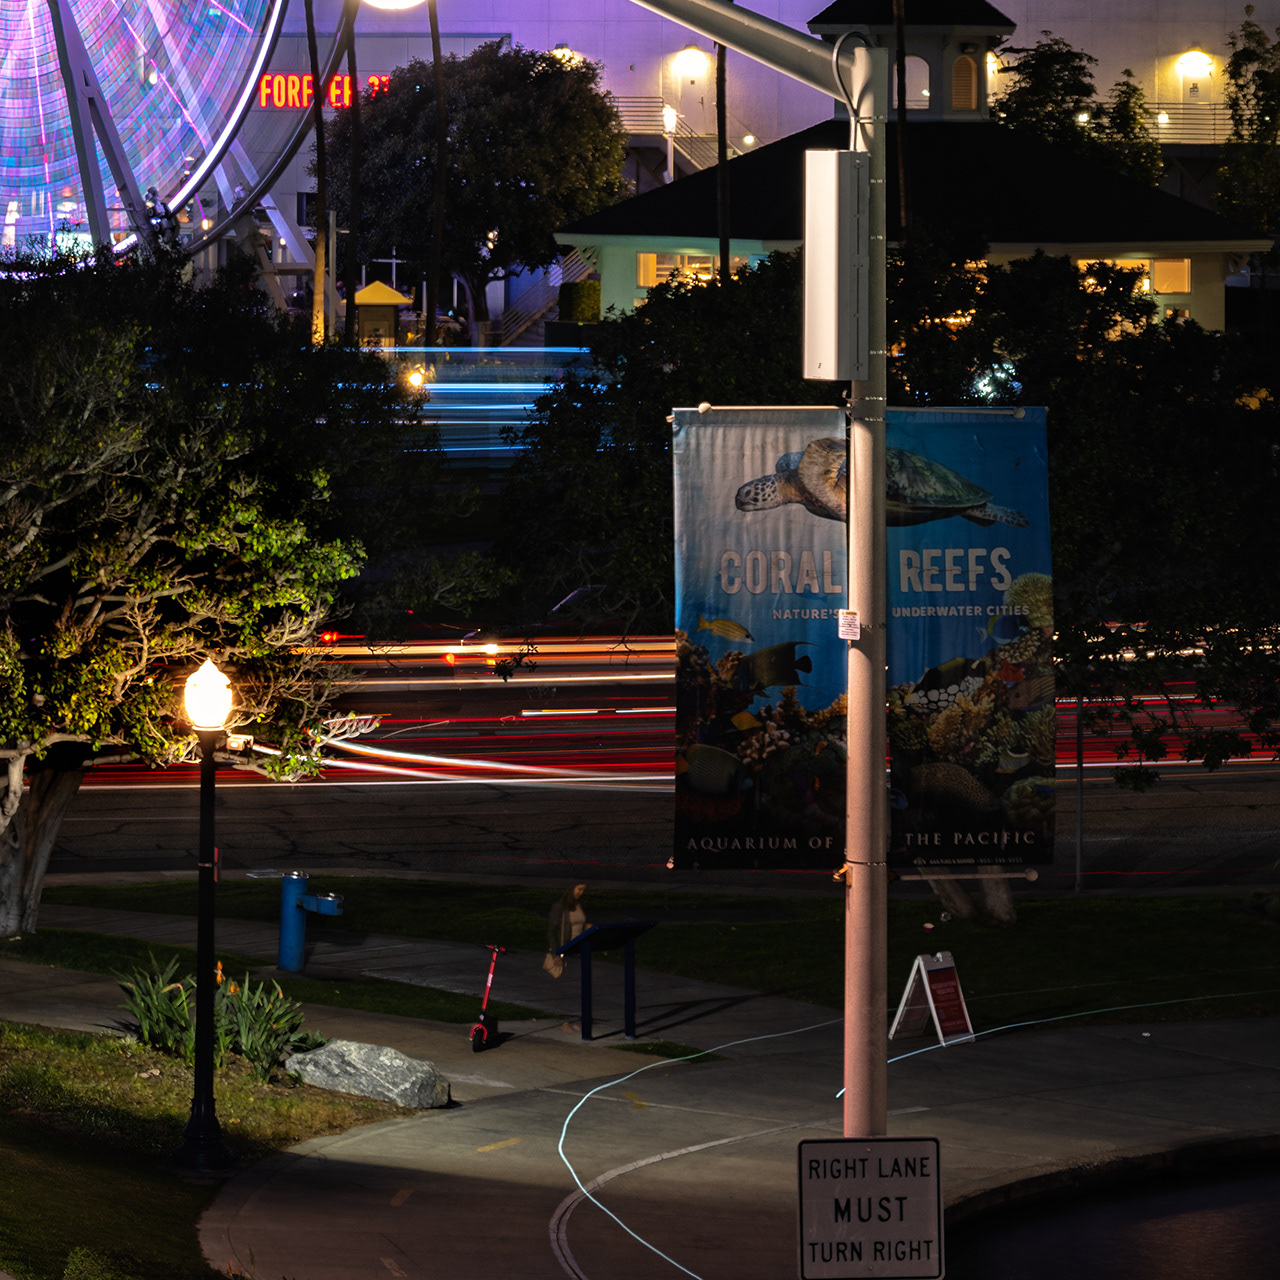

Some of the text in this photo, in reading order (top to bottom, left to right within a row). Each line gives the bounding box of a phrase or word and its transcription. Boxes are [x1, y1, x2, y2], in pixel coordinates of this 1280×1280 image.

[719, 547, 1012, 594] CORAL REEFS
[773, 605, 1030, 619] NATURE'S UNDERWATER CITIES
[687, 831, 1035, 852] AQUARIUM OF THE PACIFIC
[809, 1157, 931, 1179] RIGHT LANE
[834, 1196, 907, 1223] MUST
[809, 1240, 933, 1263] TURN RIGHT
